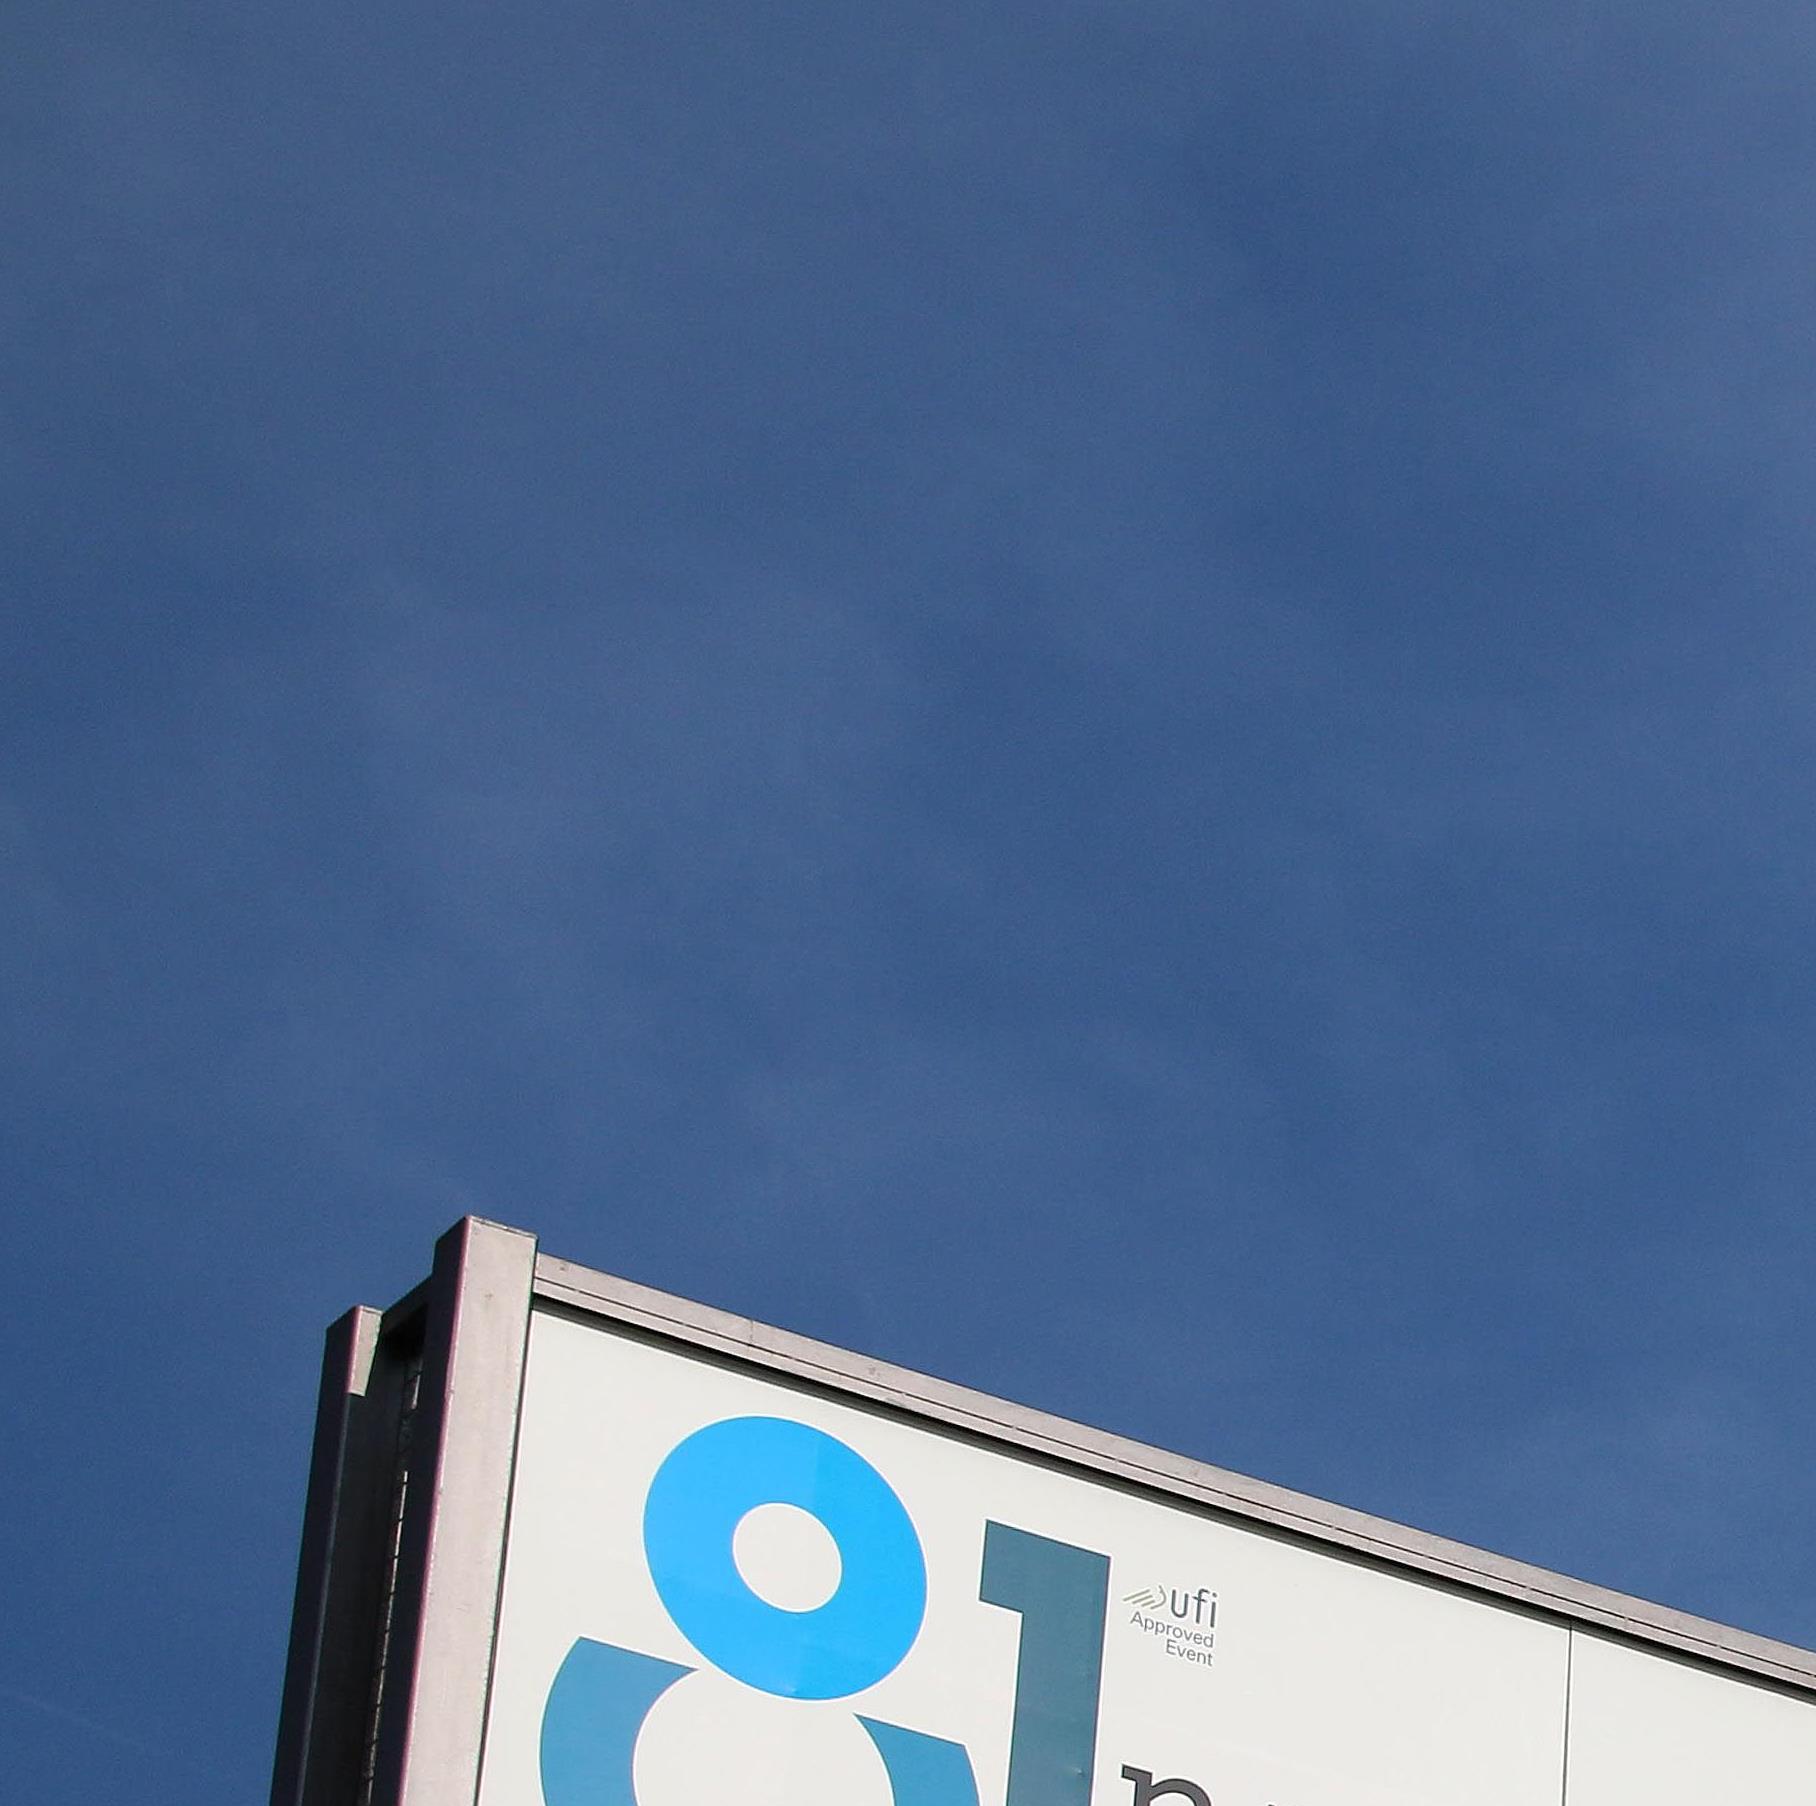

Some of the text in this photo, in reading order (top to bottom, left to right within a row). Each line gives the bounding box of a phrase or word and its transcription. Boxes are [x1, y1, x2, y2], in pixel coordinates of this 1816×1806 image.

[1171, 1588, 1217, 1628] ufi
[1130, 1611, 1214, 1648] Approved
[1166, 1639, 1212, 1667] Event
